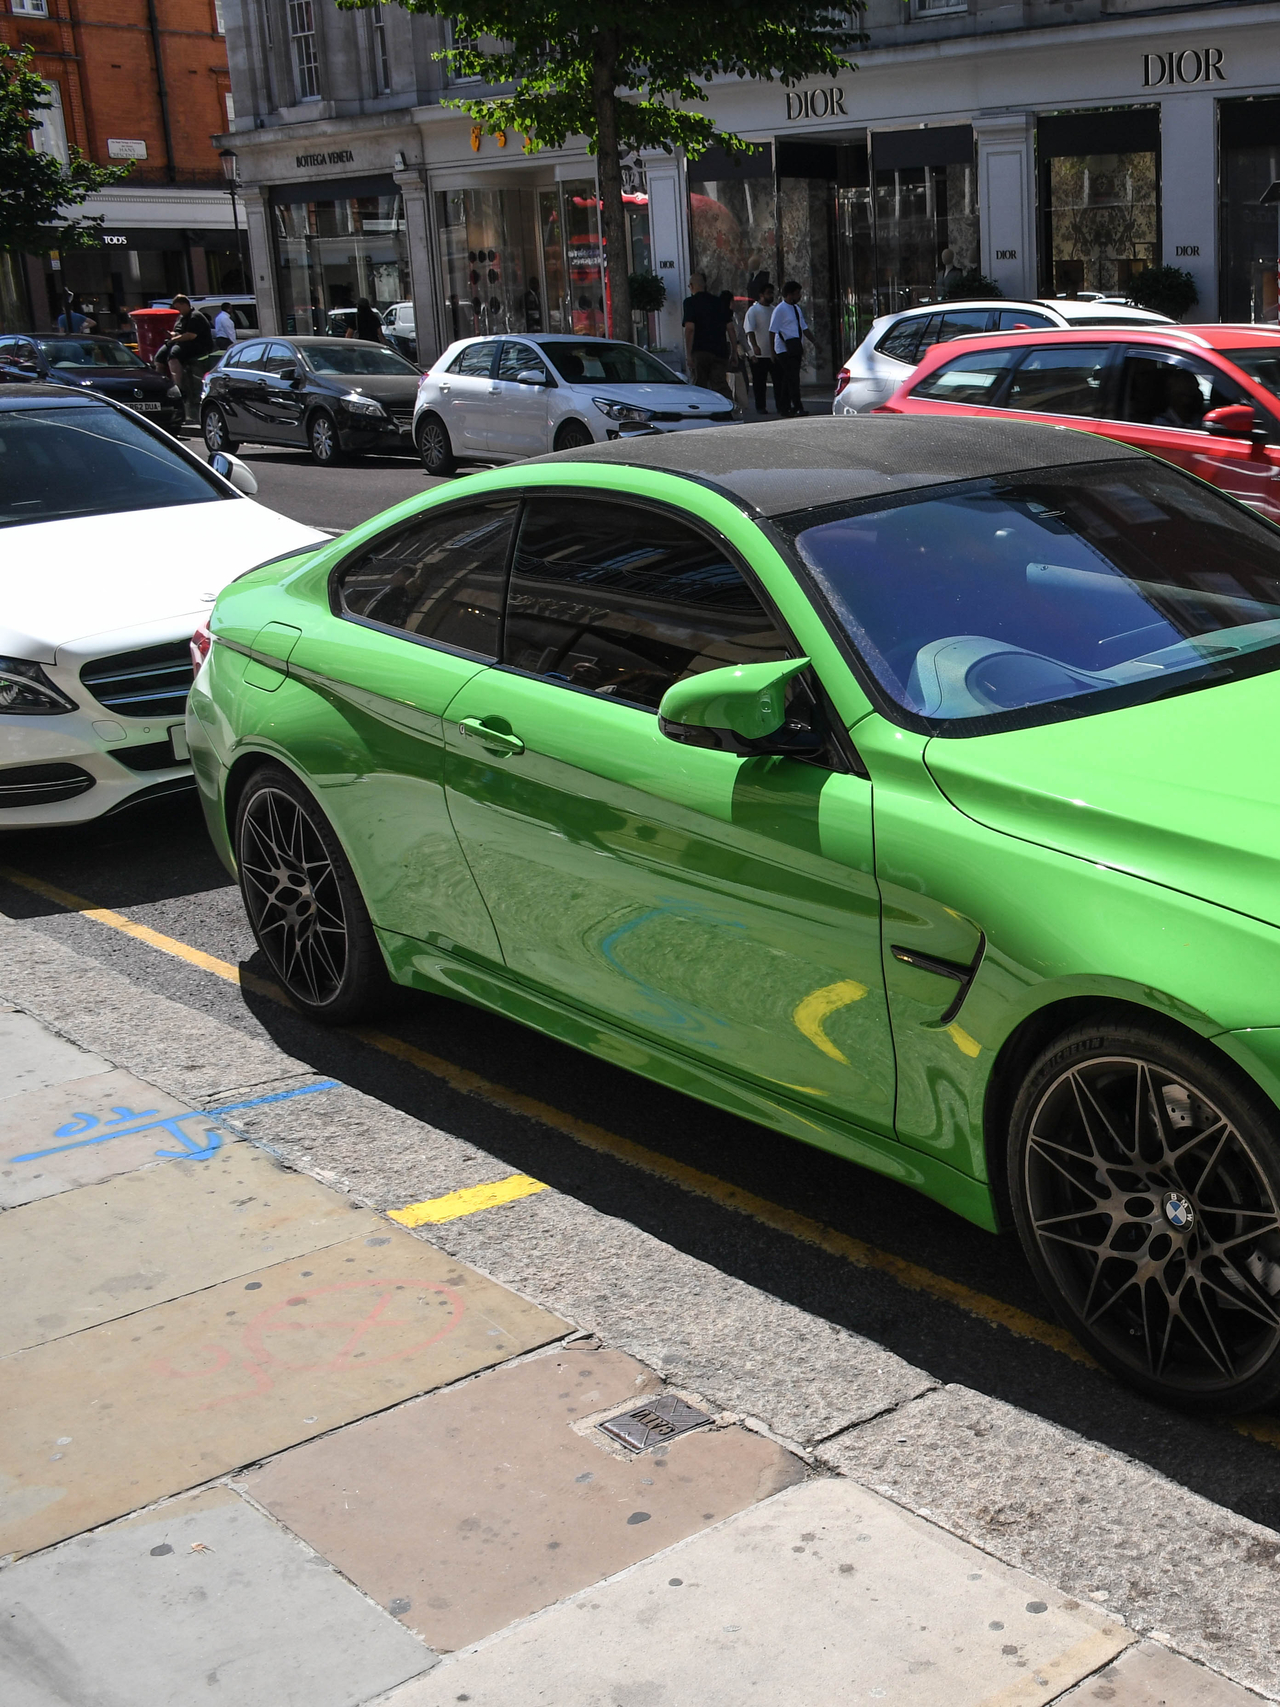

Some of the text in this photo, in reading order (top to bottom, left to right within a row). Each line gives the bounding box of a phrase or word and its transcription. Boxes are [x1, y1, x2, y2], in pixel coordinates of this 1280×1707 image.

[1141, 48, 1227, 87] DIOR
[785, 87, 848, 120] DIOR
[296, 150, 354, 168] BOTTEGA VENETA
[995, 250, 1017, 260] DIOR
[1175, 245, 1200, 256] DIOR
[659, 260, 675, 269] DIOR
[1171, 1193, 1193, 1221] BMW
[630, 1409, 676, 1435] CATV
